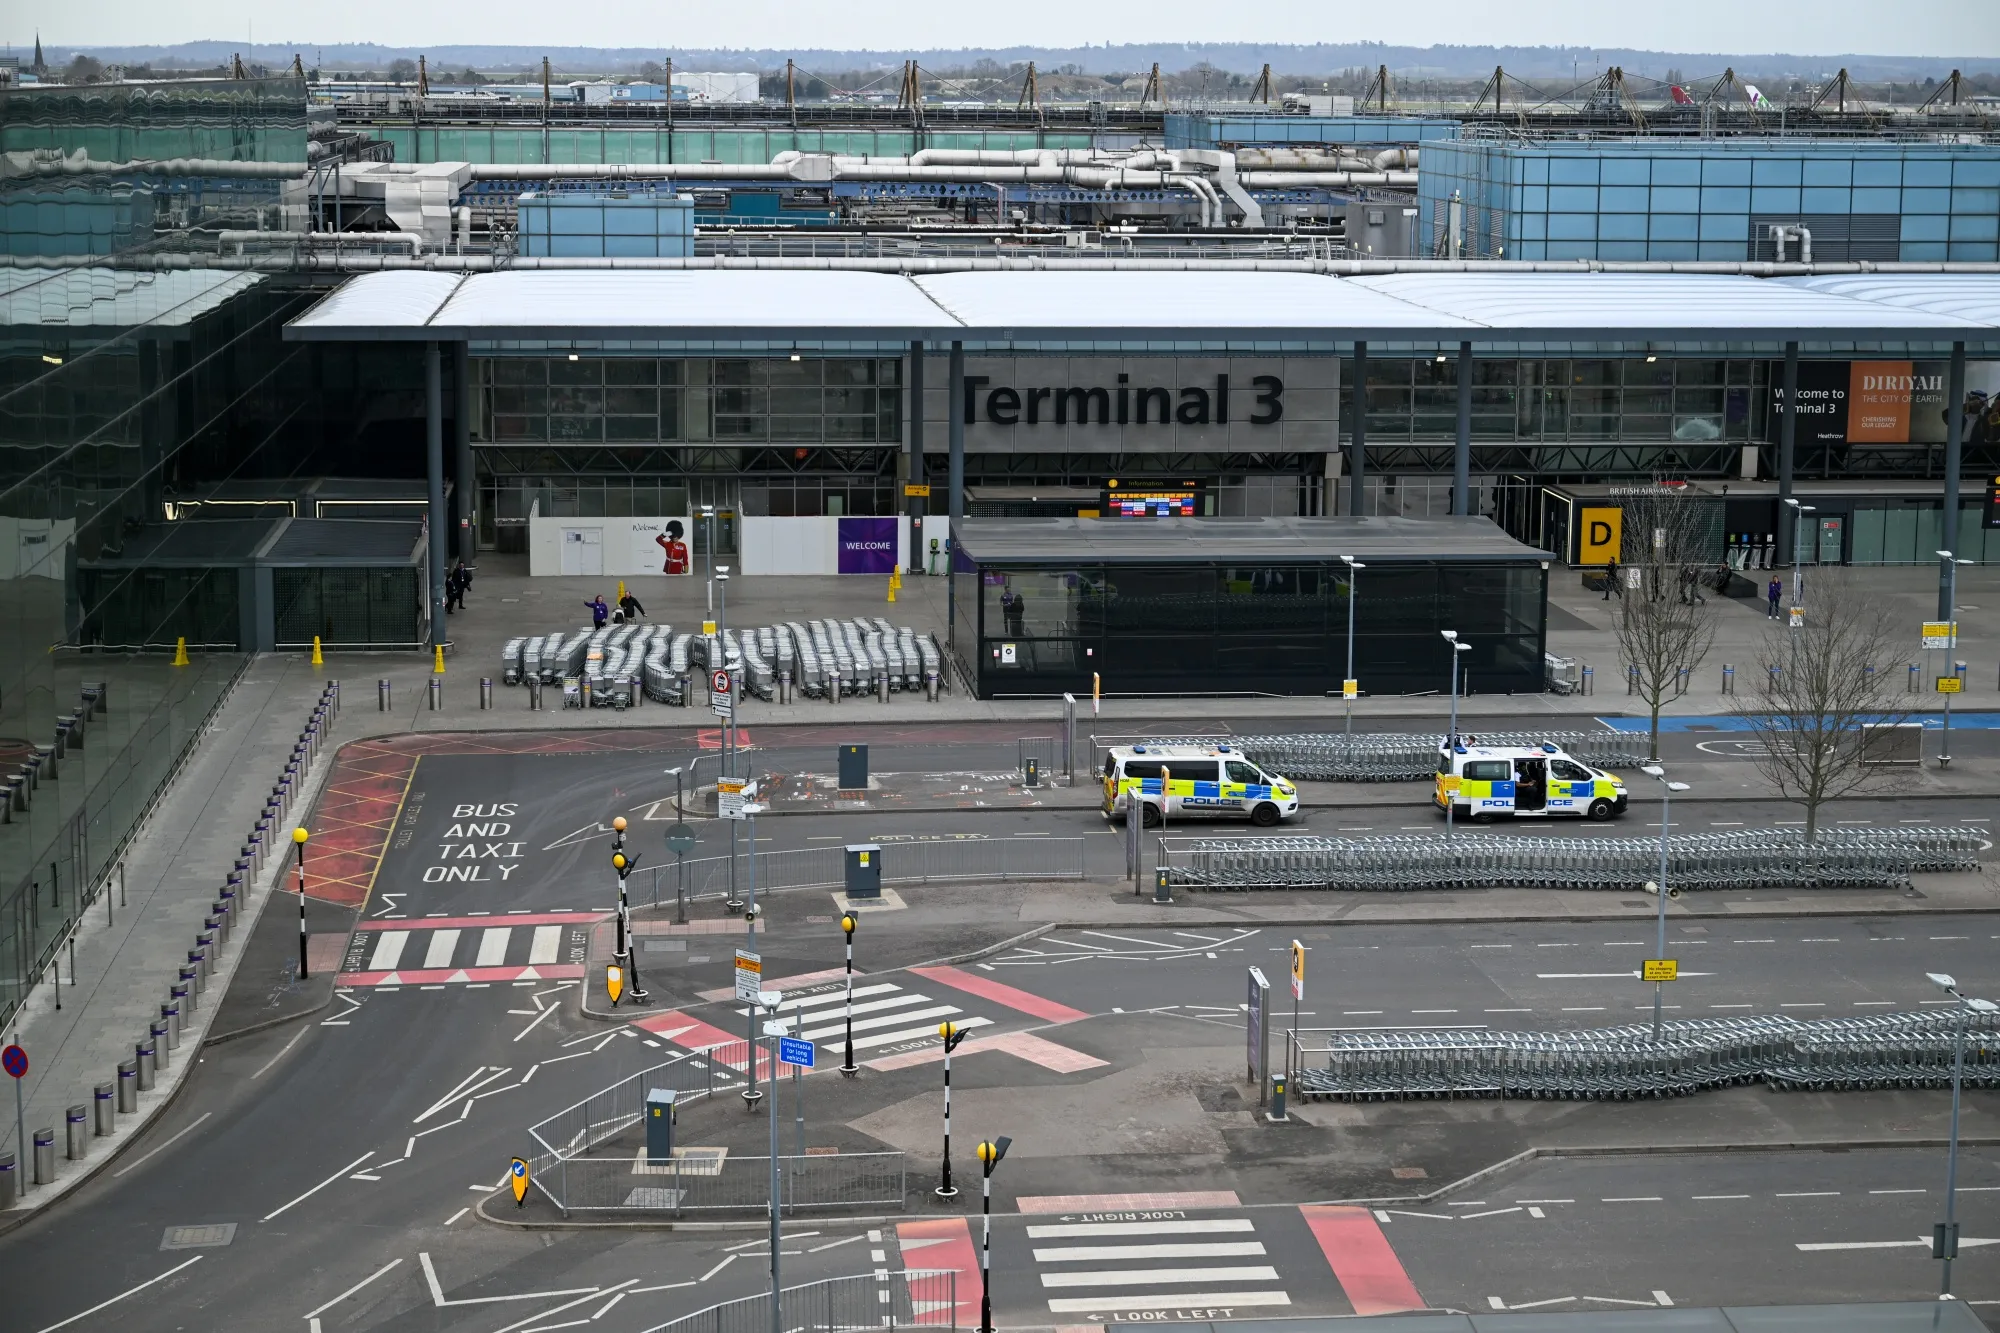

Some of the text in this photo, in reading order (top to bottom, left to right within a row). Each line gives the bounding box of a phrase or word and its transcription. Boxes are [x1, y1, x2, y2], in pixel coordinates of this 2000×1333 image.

[1863, 376, 1943, 390] DIRIYAH
[964, 374, 1283, 424] Terminal 3
[1774, 388, 1844, 399] Wlcome to
[1862, 394, 1942, 403] THE CITY OF EARTH
[1774, 403, 1836, 414] Teminal 3
[1590, 521, 1612, 546] D
[1183, 797, 1241, 806] POLICE
[452, 803, 519, 818] BUS
[443, 823, 511, 838] AND
[438, 842, 527, 859] TAXI
[422, 864, 519, 882] ONLY
[346, 932, 369, 967] LOOK RIGHT
[569, 930, 587, 963] LOOK LEFT
[807, 983, 846, 993] LOOK
[782, 1040, 812, 1050] Unsuitable
[893, 1040, 929, 1052] LOOK
[786, 1055, 808, 1063] vehicles
[1081, 1211, 1186, 1222] LOOK RIGHT
[1114, 1308, 1234, 1321] LOOK LEFT
